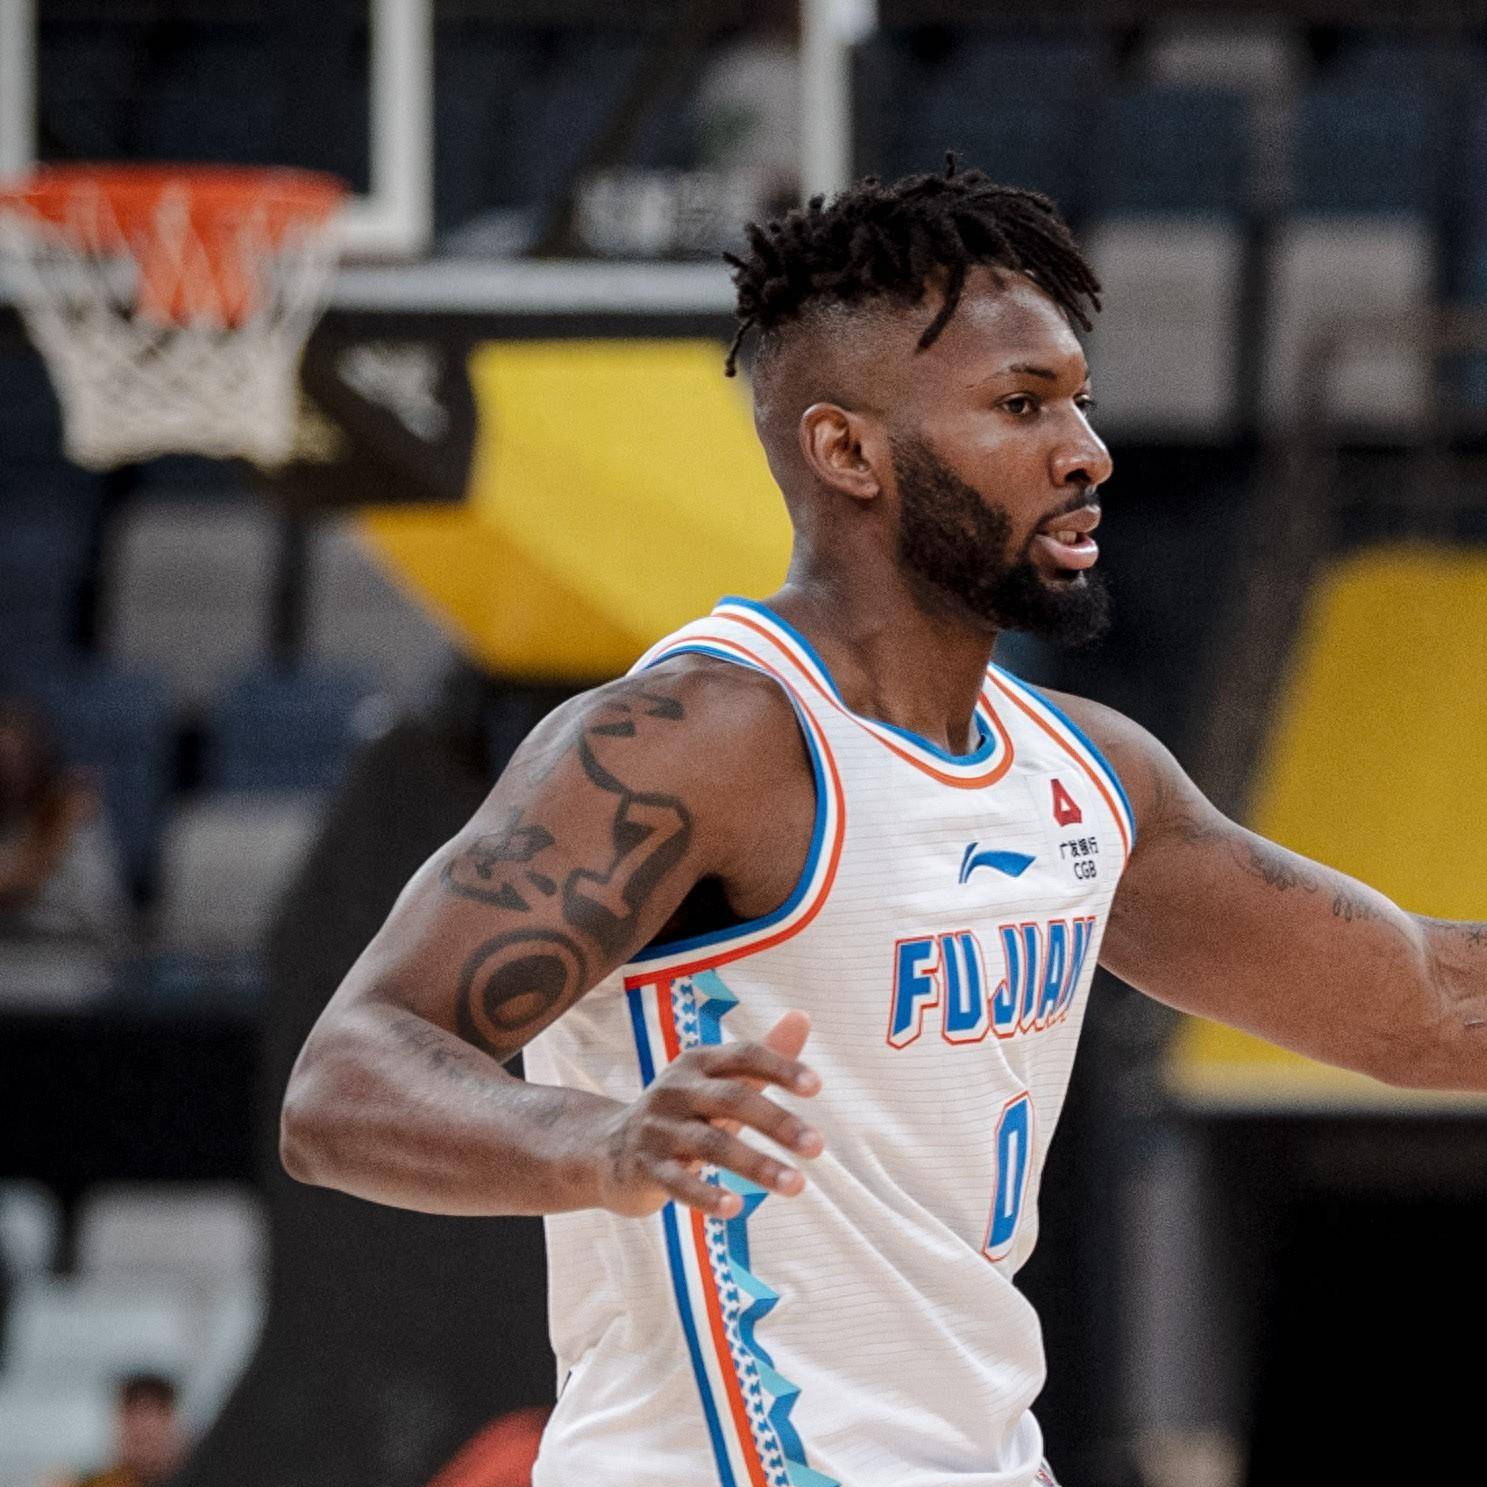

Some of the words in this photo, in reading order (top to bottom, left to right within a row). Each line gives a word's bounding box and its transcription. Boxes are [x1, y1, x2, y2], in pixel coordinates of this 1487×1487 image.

[1074, 860, 1097, 880] CGB
[886, 915, 1096, 1050] FUJIAN
[981, 1090, 1035, 1262] 0
